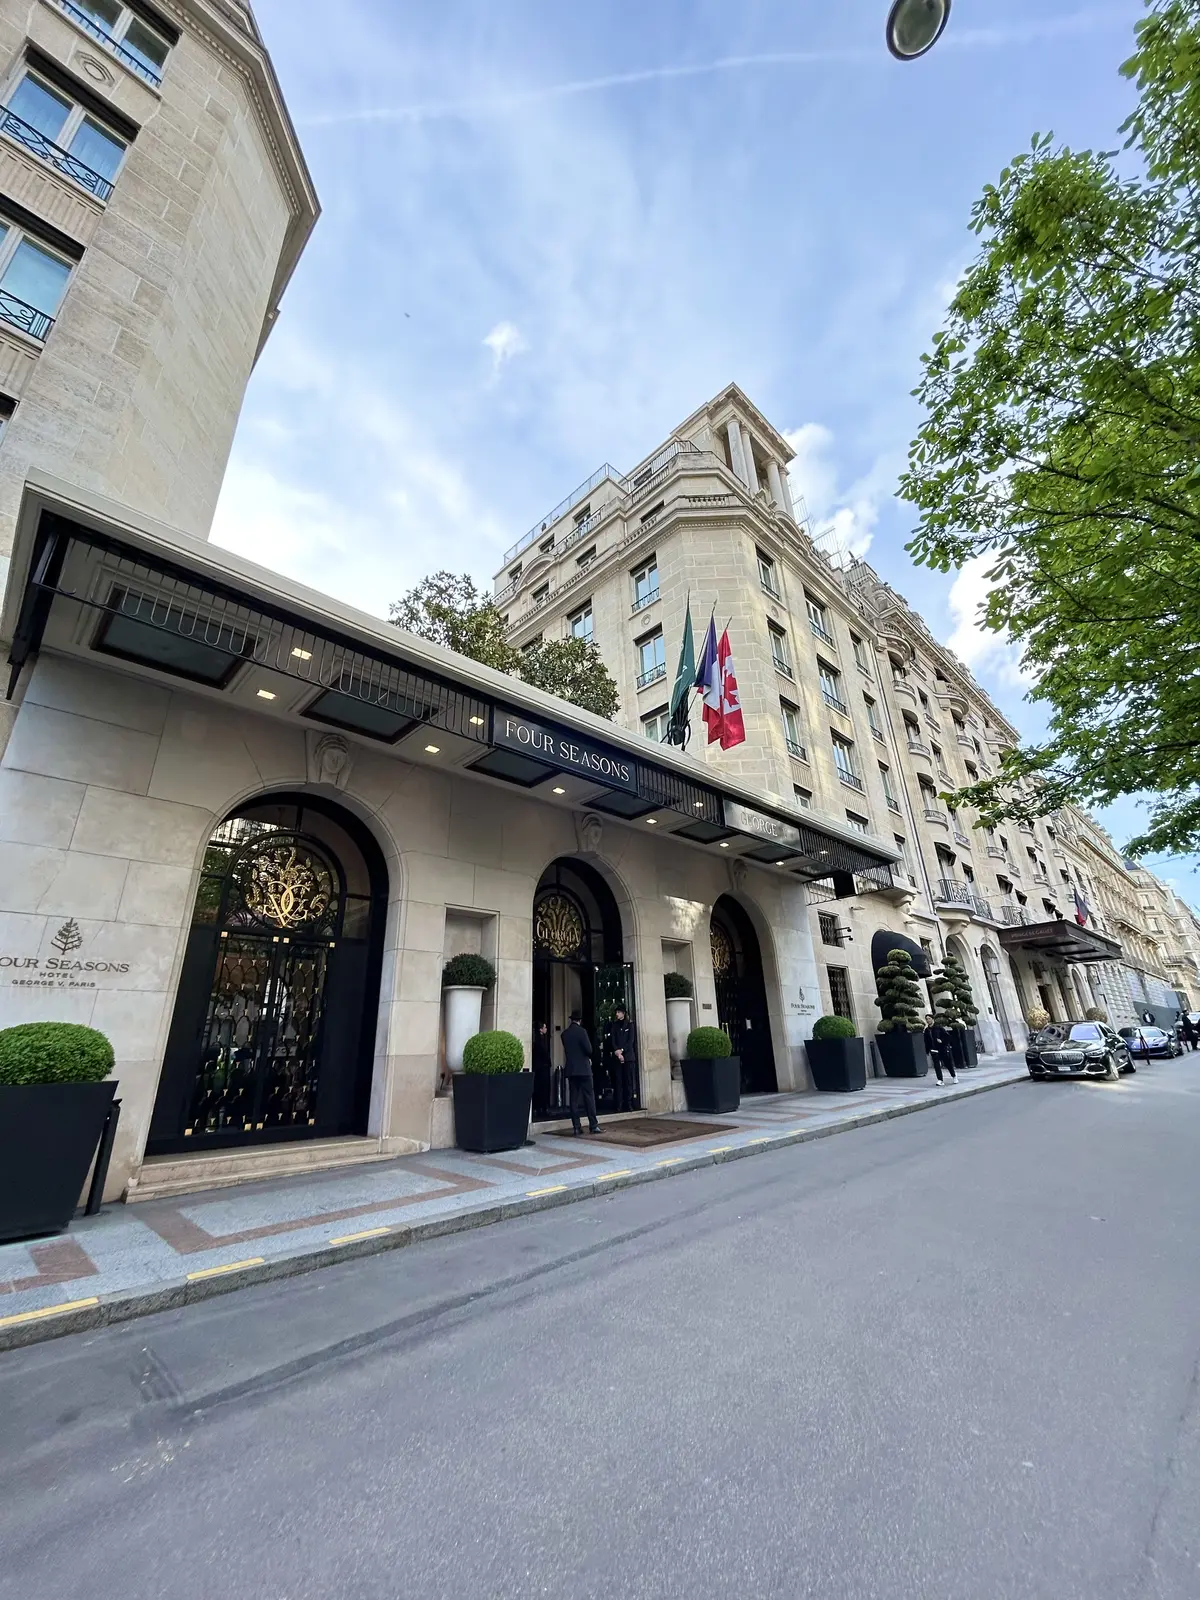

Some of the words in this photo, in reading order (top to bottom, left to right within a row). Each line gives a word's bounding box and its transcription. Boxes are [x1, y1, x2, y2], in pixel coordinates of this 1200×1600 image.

[505, 720, 555, 755] FOUR
[559, 741, 630, 782] SEASONS
[740, 811, 777, 837] GEORGE
[0, 956, 39, 968] OUR
[45, 958, 130, 972] SEASONS
[11, 979, 54, 987] GEORGE
